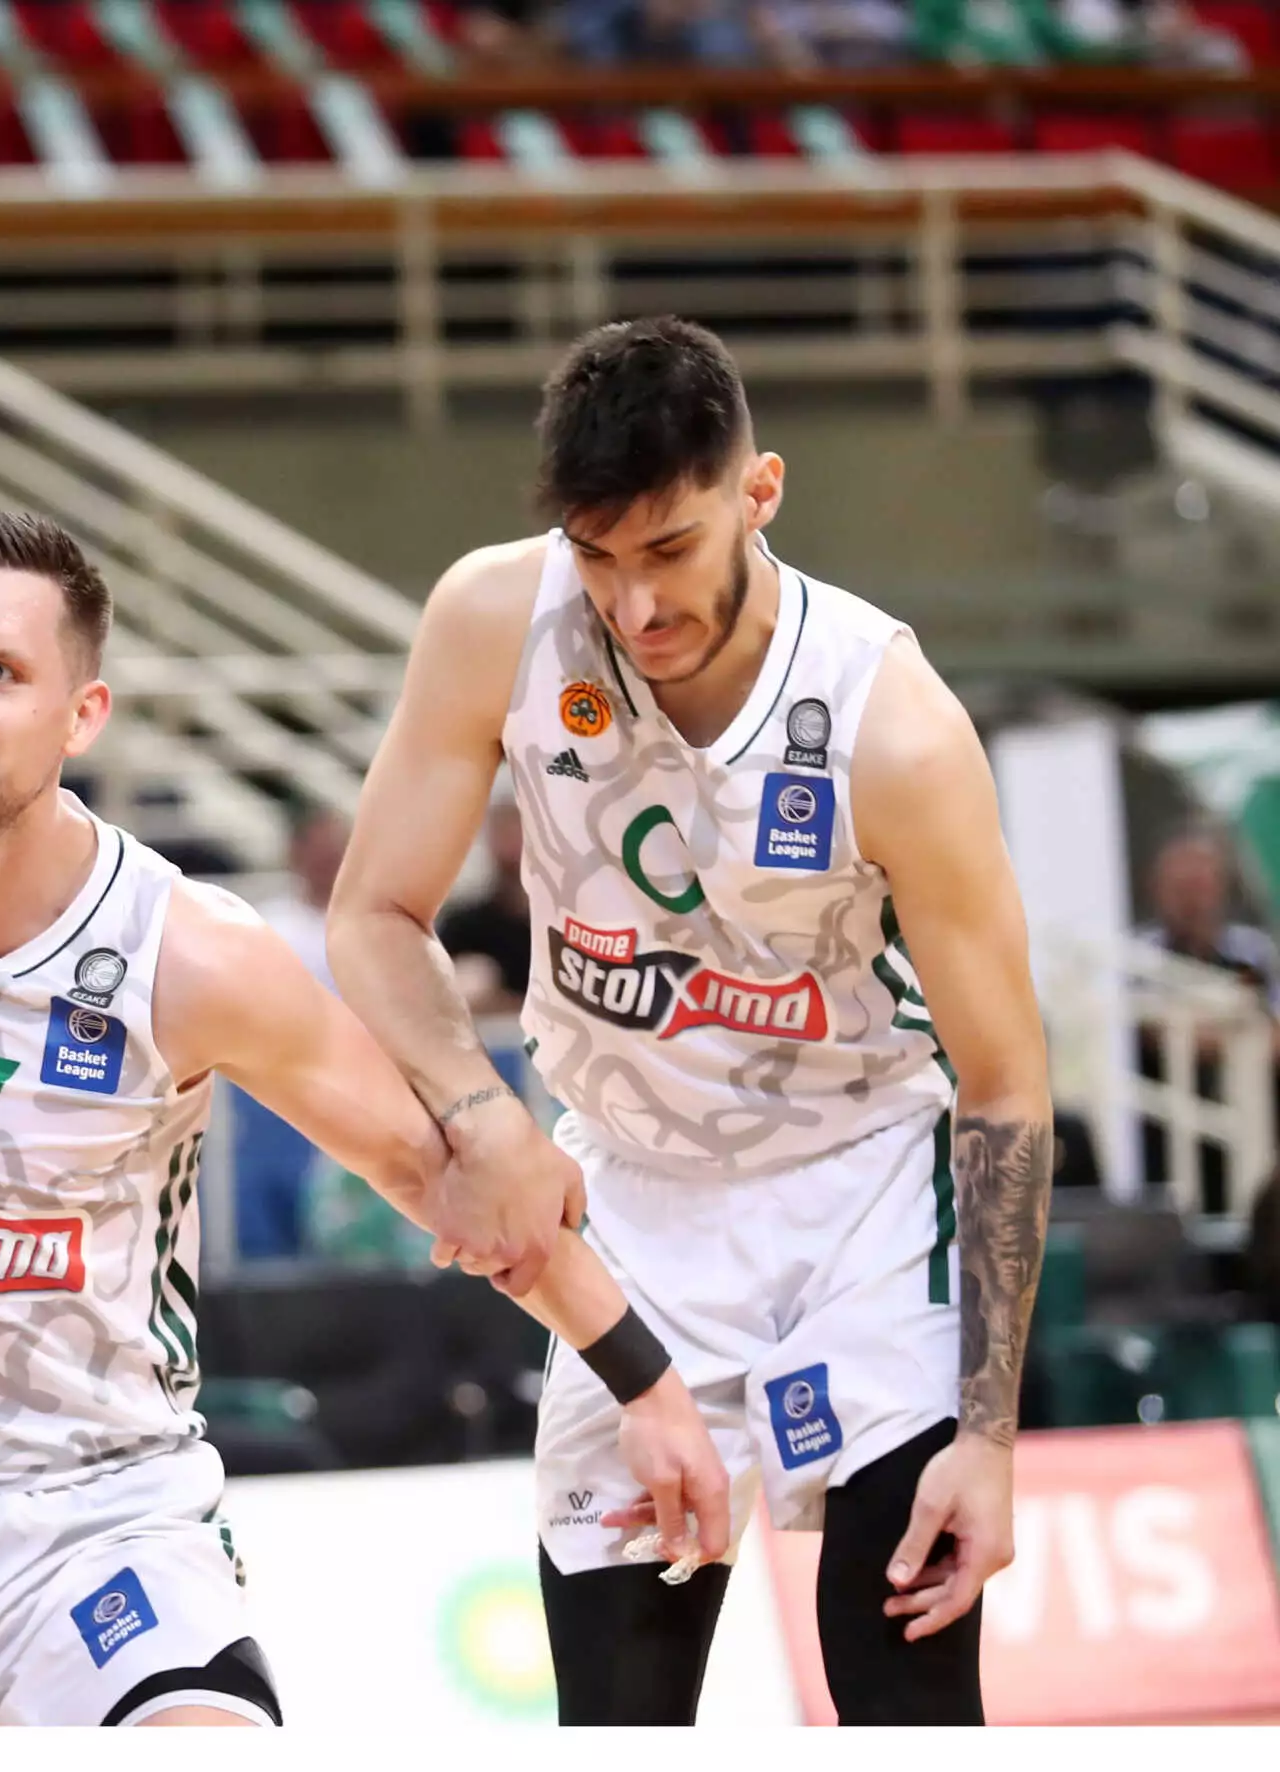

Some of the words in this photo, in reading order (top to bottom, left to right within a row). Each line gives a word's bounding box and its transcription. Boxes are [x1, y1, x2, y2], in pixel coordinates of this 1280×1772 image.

[770, 828, 818, 845] Basket
[768, 840, 817, 860] League
[567, 922, 630, 959] pame
[58, 1046, 108, 1067] Basket
[55, 1060, 106, 1080] League
[982, 1484, 1212, 1641] VIS
